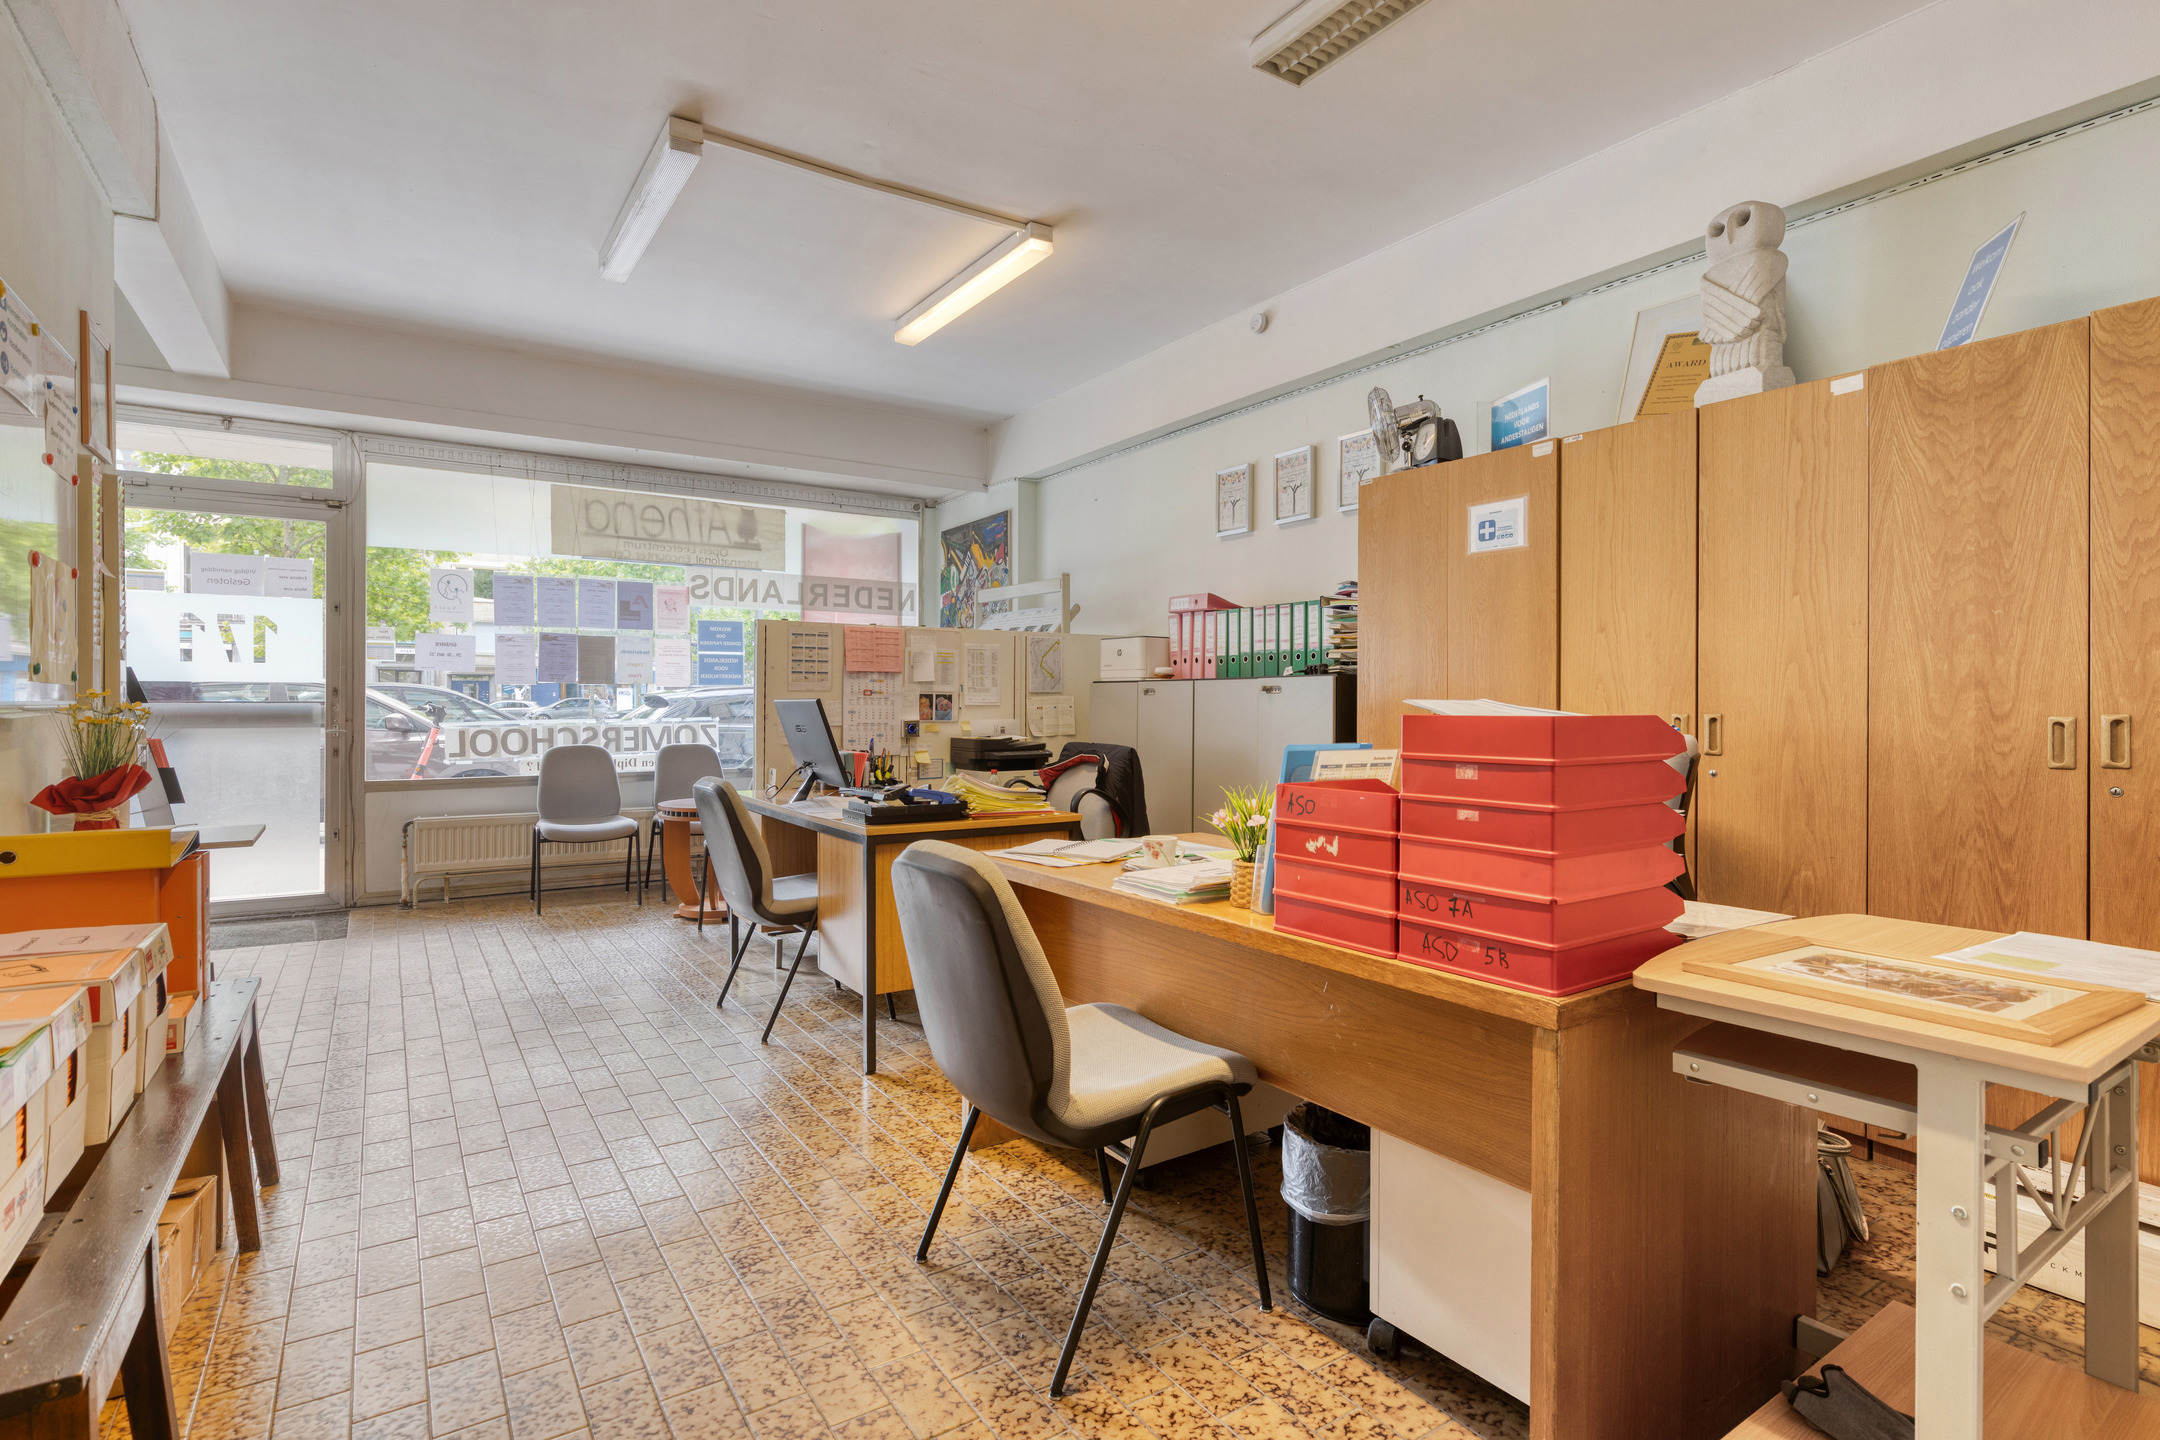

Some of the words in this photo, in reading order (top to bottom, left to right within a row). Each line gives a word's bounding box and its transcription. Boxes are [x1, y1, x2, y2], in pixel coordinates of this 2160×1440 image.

[1971, 246, 2004, 275] Welkom
[1967, 275, 1985, 296] ook
[1951, 298, 1981, 325] zonder
[1940, 322, 1974, 350] papieren
[1666, 359, 1707, 369] AWARD
[1504, 401, 1540, 421] NEDERLANDS
[1513, 416, 1530, 429] VOOR
[1500, 422, 1544, 445] ANDERSTALIGEN
[1286, 792, 1316, 816] ASO
[1405, 888, 1439, 912] ASO
